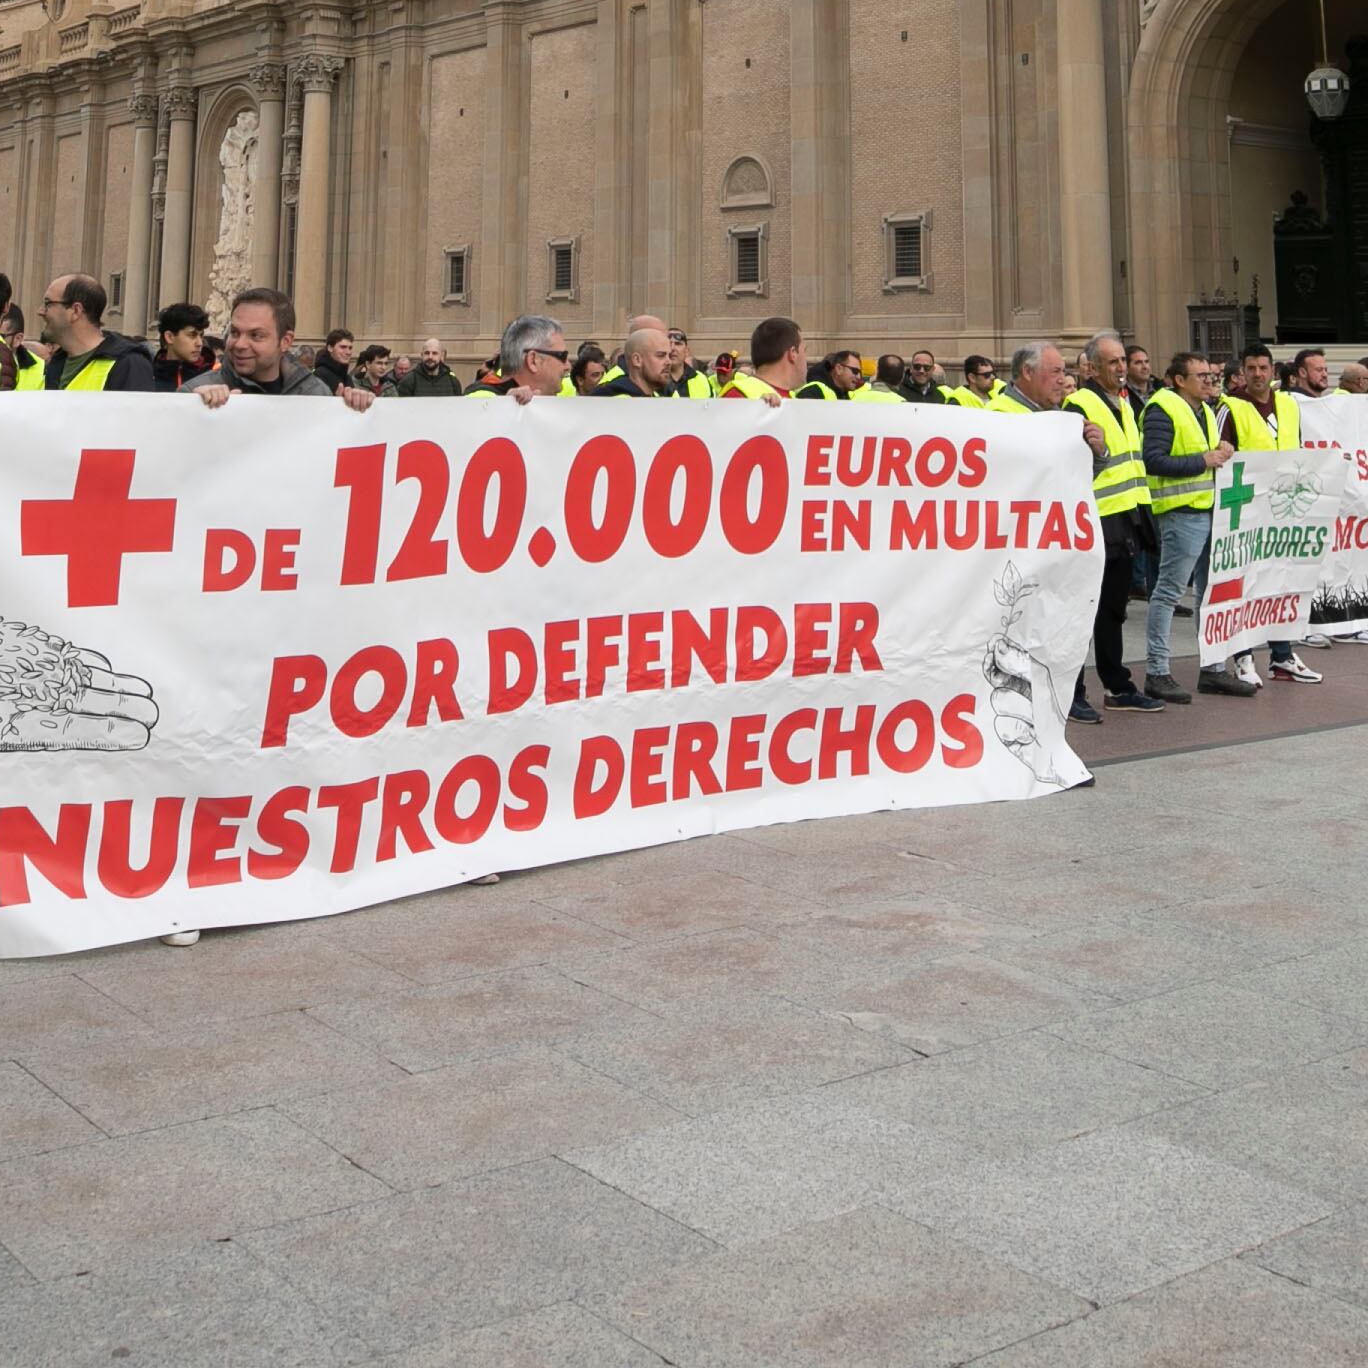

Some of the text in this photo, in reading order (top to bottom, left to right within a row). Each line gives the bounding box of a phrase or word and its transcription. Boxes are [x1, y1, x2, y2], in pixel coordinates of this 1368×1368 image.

[803, 435, 988, 488] EUROS
[203, 528, 300, 593] DE
[333, 434, 790, 585] 120.000
[800, 499, 1095, 553] EN MULTAS
[1212, 526, 1328, 573] CULTIVADORES
[260, 601, 884, 749] POR DEFENDER
[572, 693, 984, 820] DERECHOS
